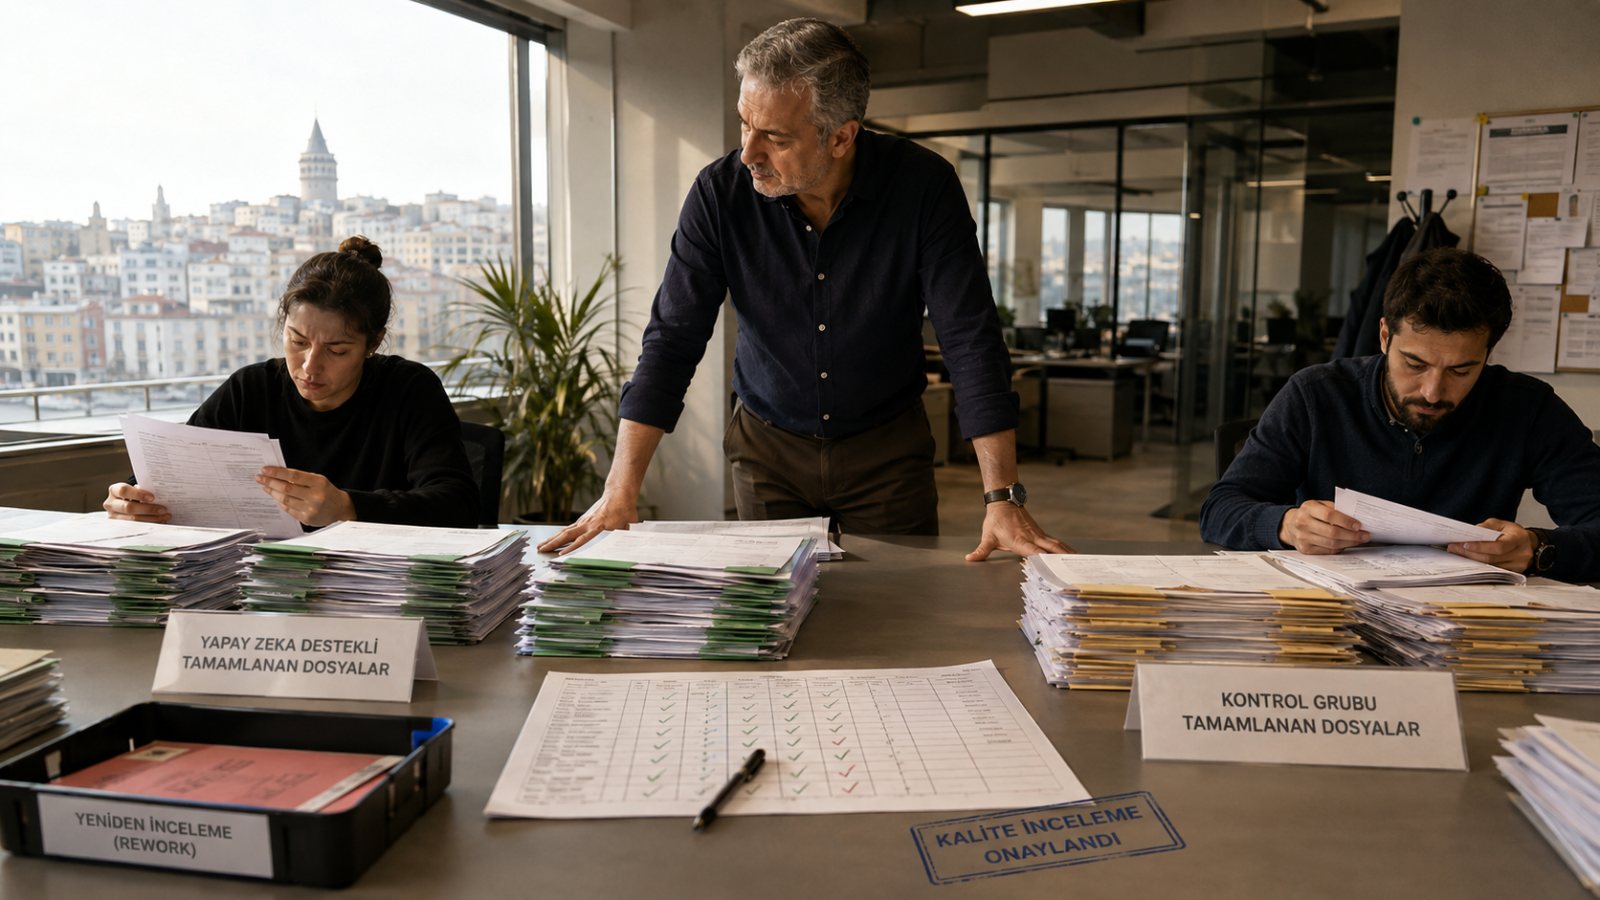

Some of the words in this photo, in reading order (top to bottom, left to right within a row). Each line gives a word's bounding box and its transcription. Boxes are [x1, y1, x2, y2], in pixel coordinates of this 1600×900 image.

[200, 635, 251, 650] YAPAY
[254, 637, 296, 652] ZEKA
[301, 638, 378, 654] DESTEKLİ
[183, 656, 298, 673] TAMAMLANAN
[303, 660, 390, 676] DOSYALAR
[1221, 692, 1308, 709] KONTROL
[1313, 695, 1377, 711] GRUBU
[1182, 715, 1316, 734] TAMAMLANAN
[1322, 719, 1421, 737] DOSYALAR
[75, 812, 145, 831] YENİDEN
[149, 816, 232, 840] İNCELEME
[935, 822, 1018, 847] KALİTE
[1021, 805, 1143, 834] İNCELEME
[113, 835, 197, 859] (REWORK)
[984, 832, 1122, 864] ONAYLANDI
